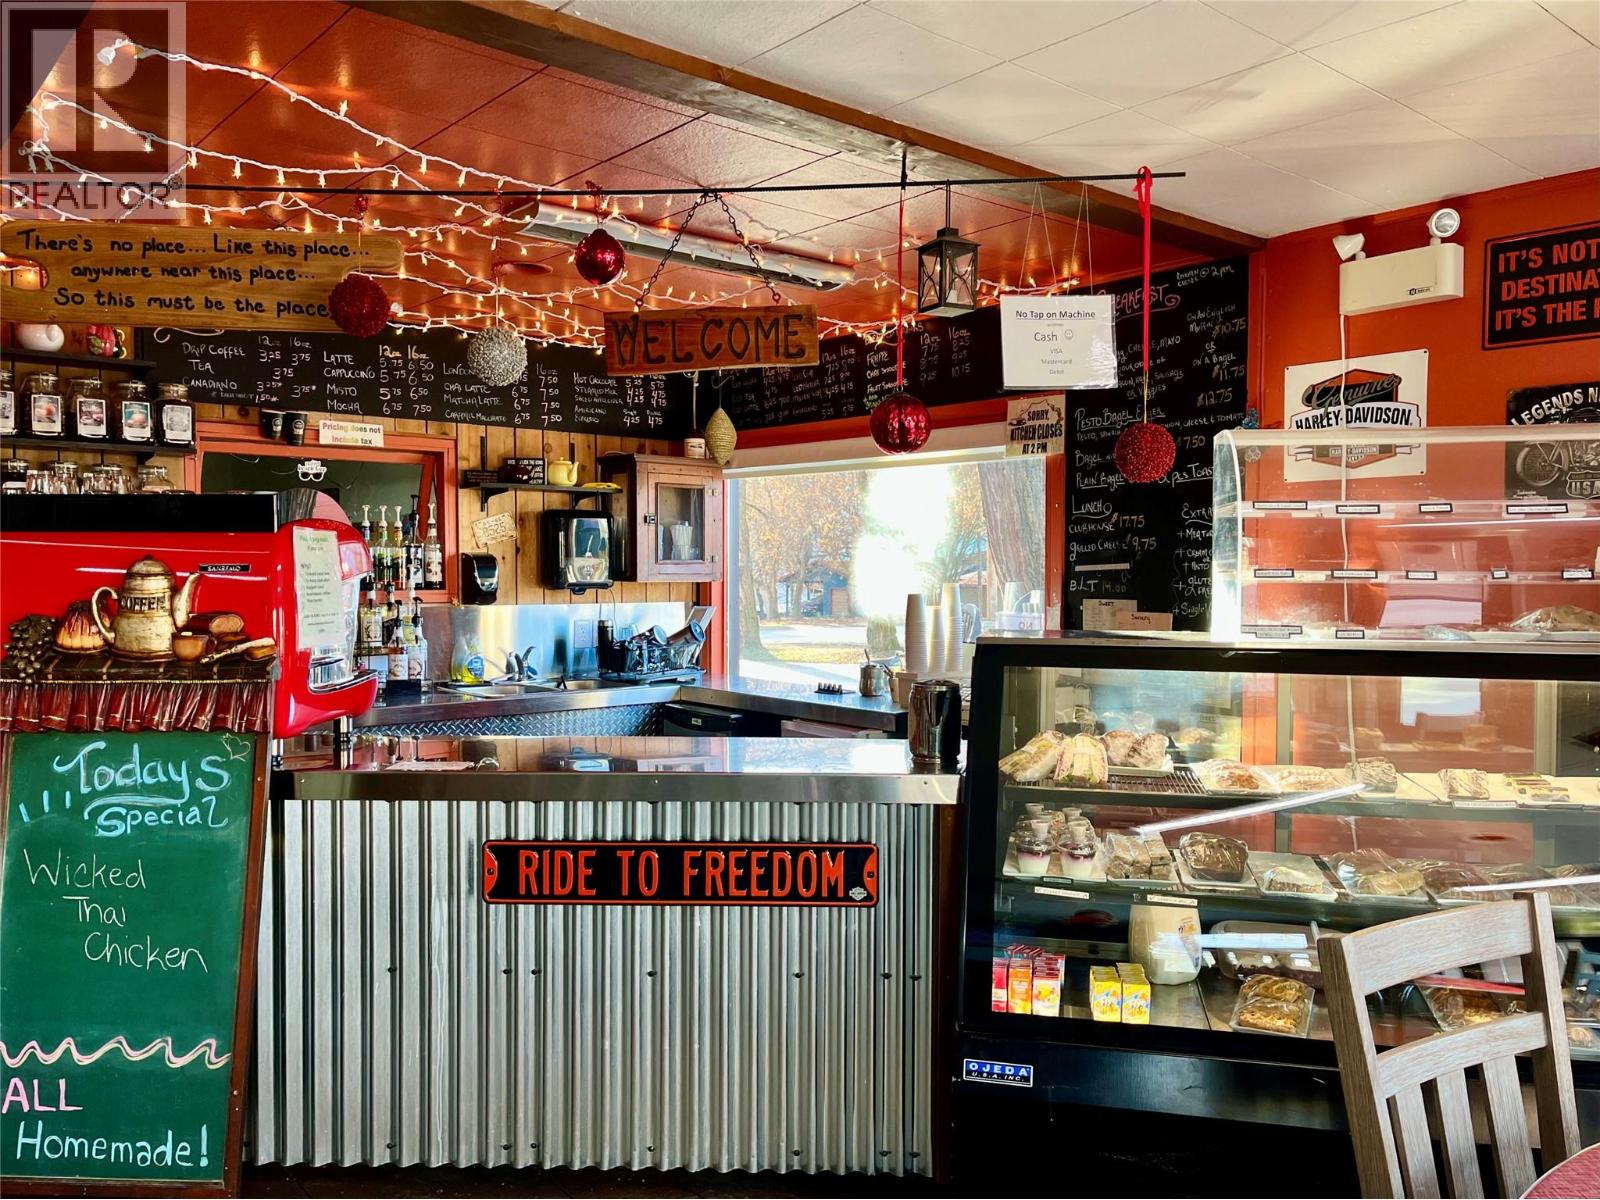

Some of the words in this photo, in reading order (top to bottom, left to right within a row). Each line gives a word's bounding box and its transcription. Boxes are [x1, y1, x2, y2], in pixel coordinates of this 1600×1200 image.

[17, 229, 93, 252] There's
[110, 240, 133, 253] no
[214, 234, 254, 256] Like
[262, 240, 297, 257] this
[1498, 247, 1543, 273] IT'S
[1552, 238, 1600, 265] NOT
[71, 264, 152, 284] anywhere
[160, 266, 201, 279] near
[208, 265, 243, 280] this
[54, 287, 85, 307] So
[96, 291, 135, 308] this
[147, 296, 196, 311] must
[204, 296, 226, 311] be
[235, 297, 266, 314] the
[1016, 310, 1027, 318] No
[1030, 310, 1044, 320] Tap
[1059, 310, 1096, 319] Machine
[1495, 306, 1537, 331] IT'S
[1543, 300, 1586, 324] THE
[612, 313, 806, 367] WELCOME
[1034, 332, 1058, 342] Cash
[187, 359, 214, 374] TEA
[324, 350, 354, 365] LATTE
[324, 366, 375, 379] CAPPUCCINO
[327, 384, 357, 396] MISTO
[327, 400, 363, 414] MOCHA
[369, 426, 381, 434] not
[1010, 425, 1037, 441] KITCHEN
[1037, 424, 1062, 438] CLOSES
[1022, 444, 1031, 454] AT
[1031, 444, 1036, 454] 2
[1036, 443, 1047, 454] PM
[24, 848, 147, 891] Wicked
[518, 849, 597, 896] RIDE
[616, 850, 659, 897] TO
[683, 849, 845, 898] FREEDOM
[62, 896, 126, 926] Thai
[84, 932, 208, 973] Chicken
[1, 1077, 83, 1113] ALL
[16, 1121, 209, 1167] Homemade!
